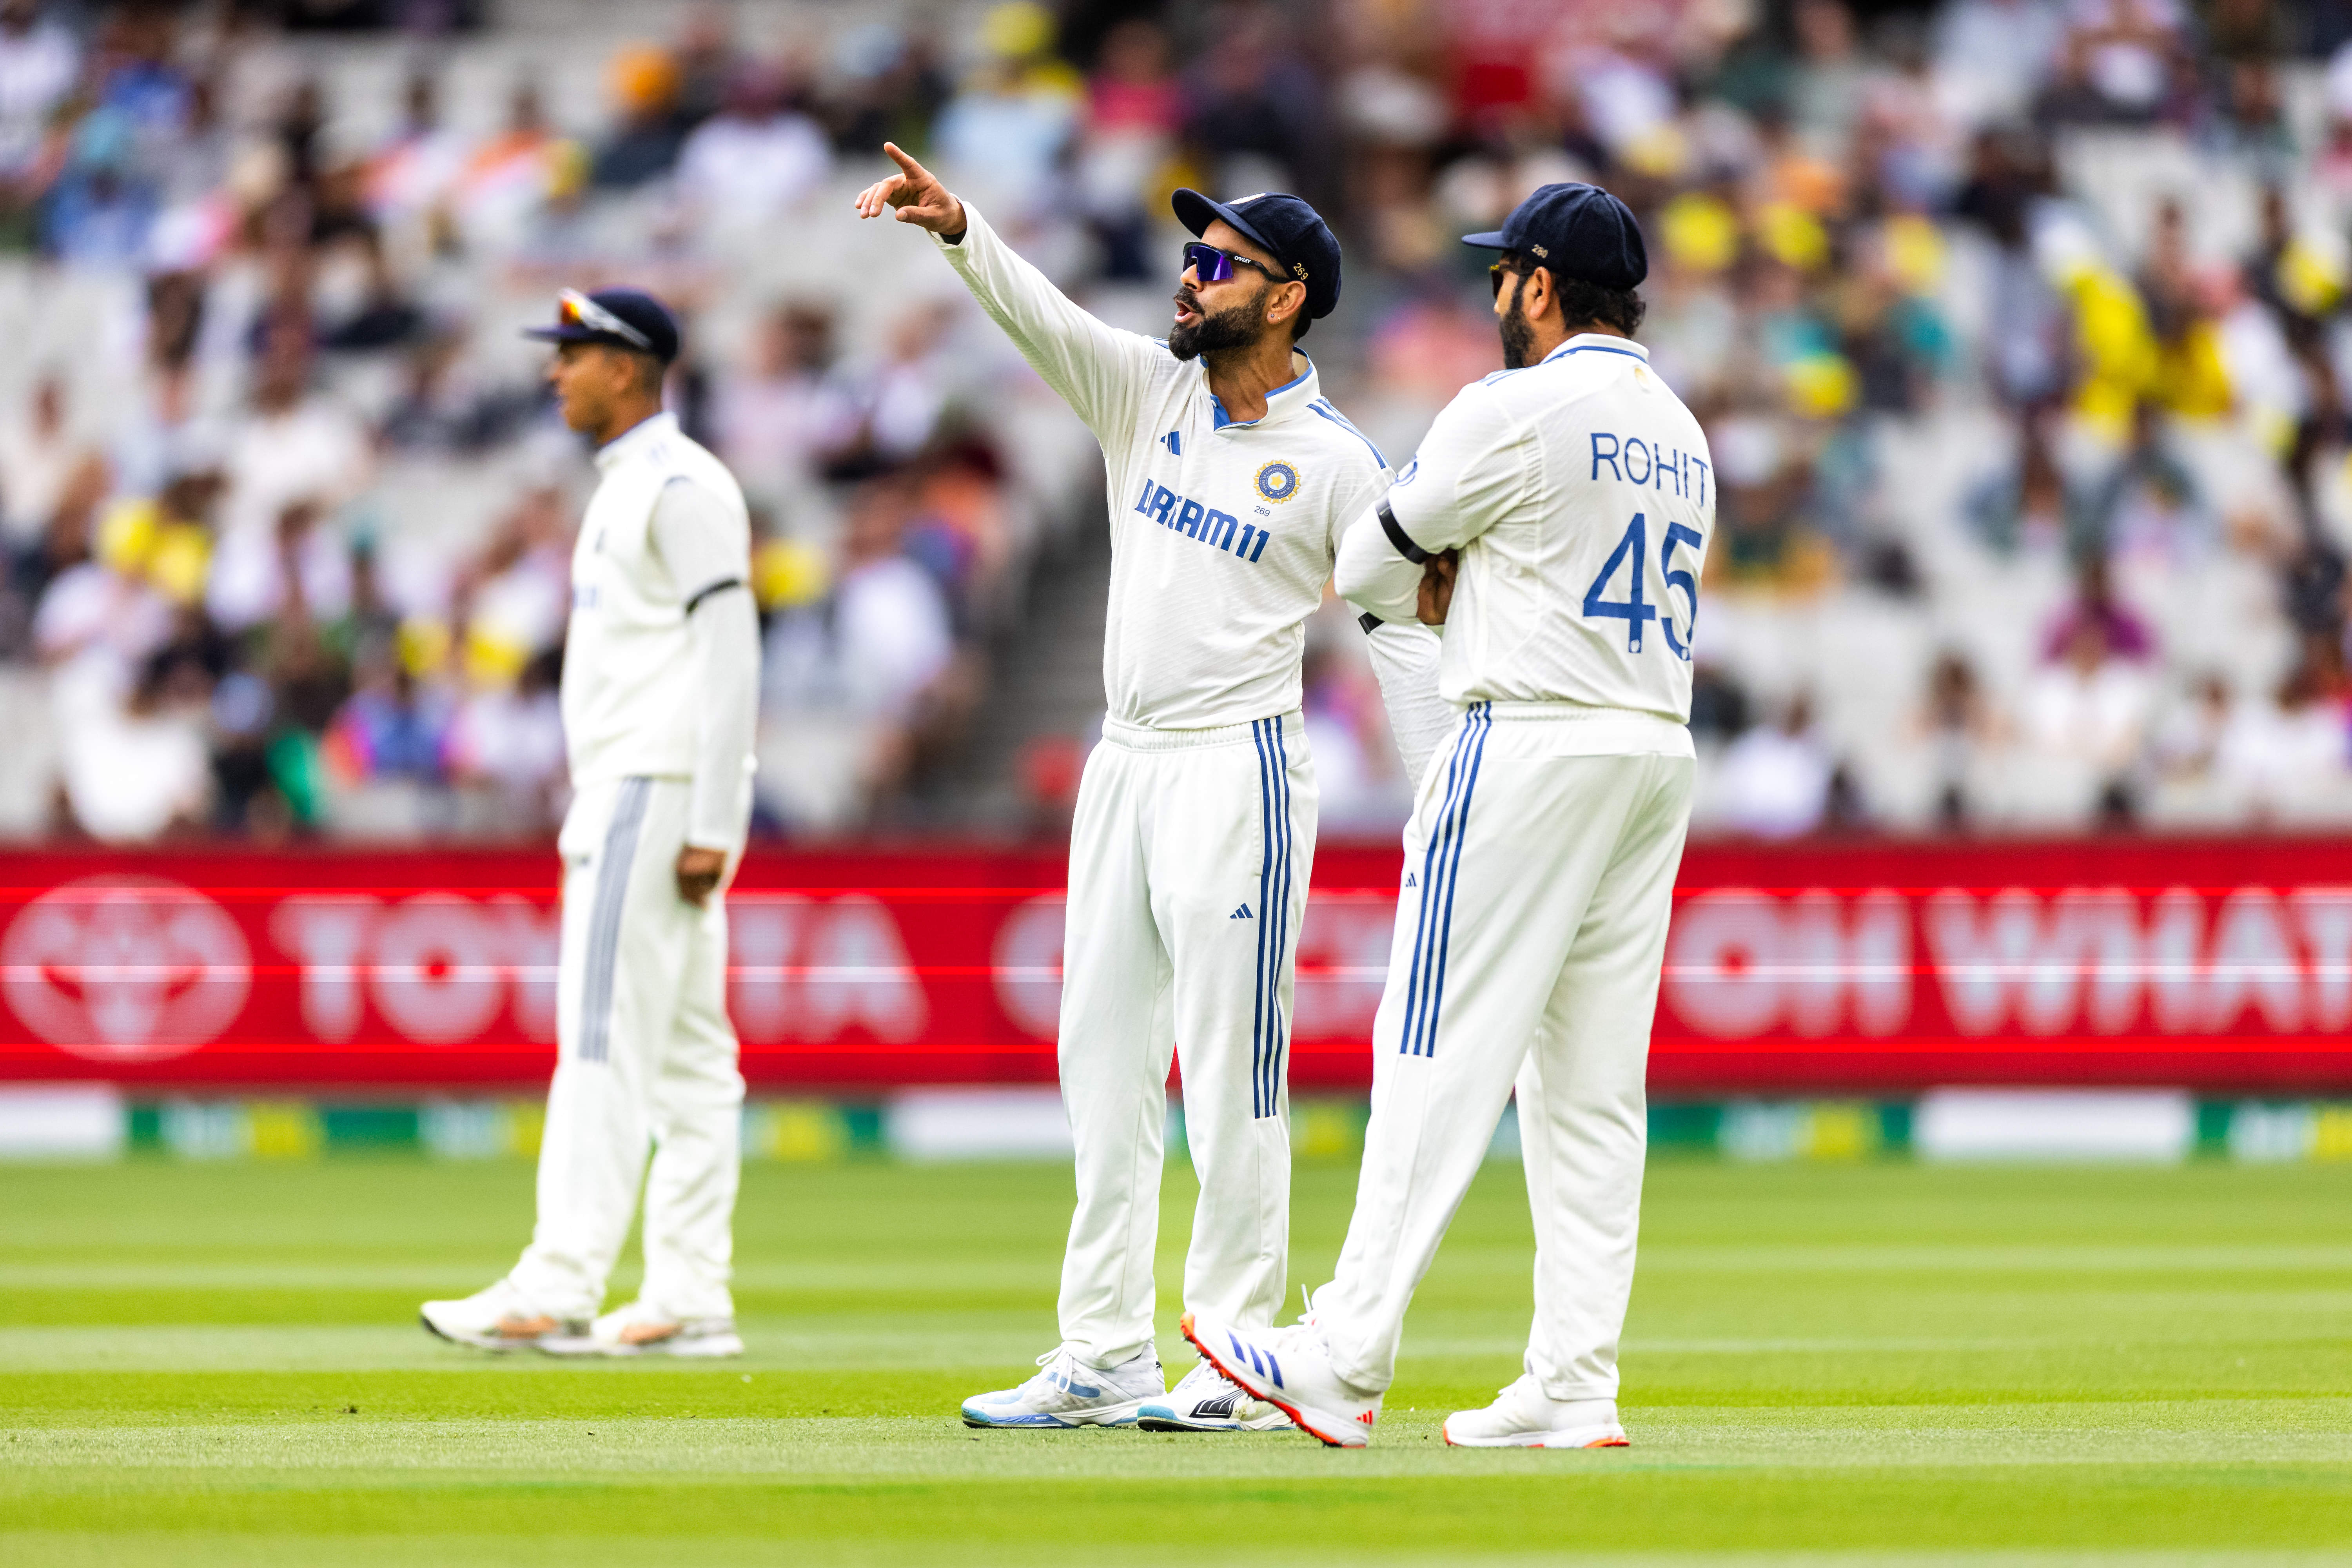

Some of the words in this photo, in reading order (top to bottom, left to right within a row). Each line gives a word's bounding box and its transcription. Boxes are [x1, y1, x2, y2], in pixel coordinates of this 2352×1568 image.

[1294, 263, 1308, 280] 269
[1591, 433, 1708, 507] ROHIT
[1254, 505, 1270, 517] 269
[1583, 513, 1702, 661] 45
[269, 890, 928, 1045] TOYTA
